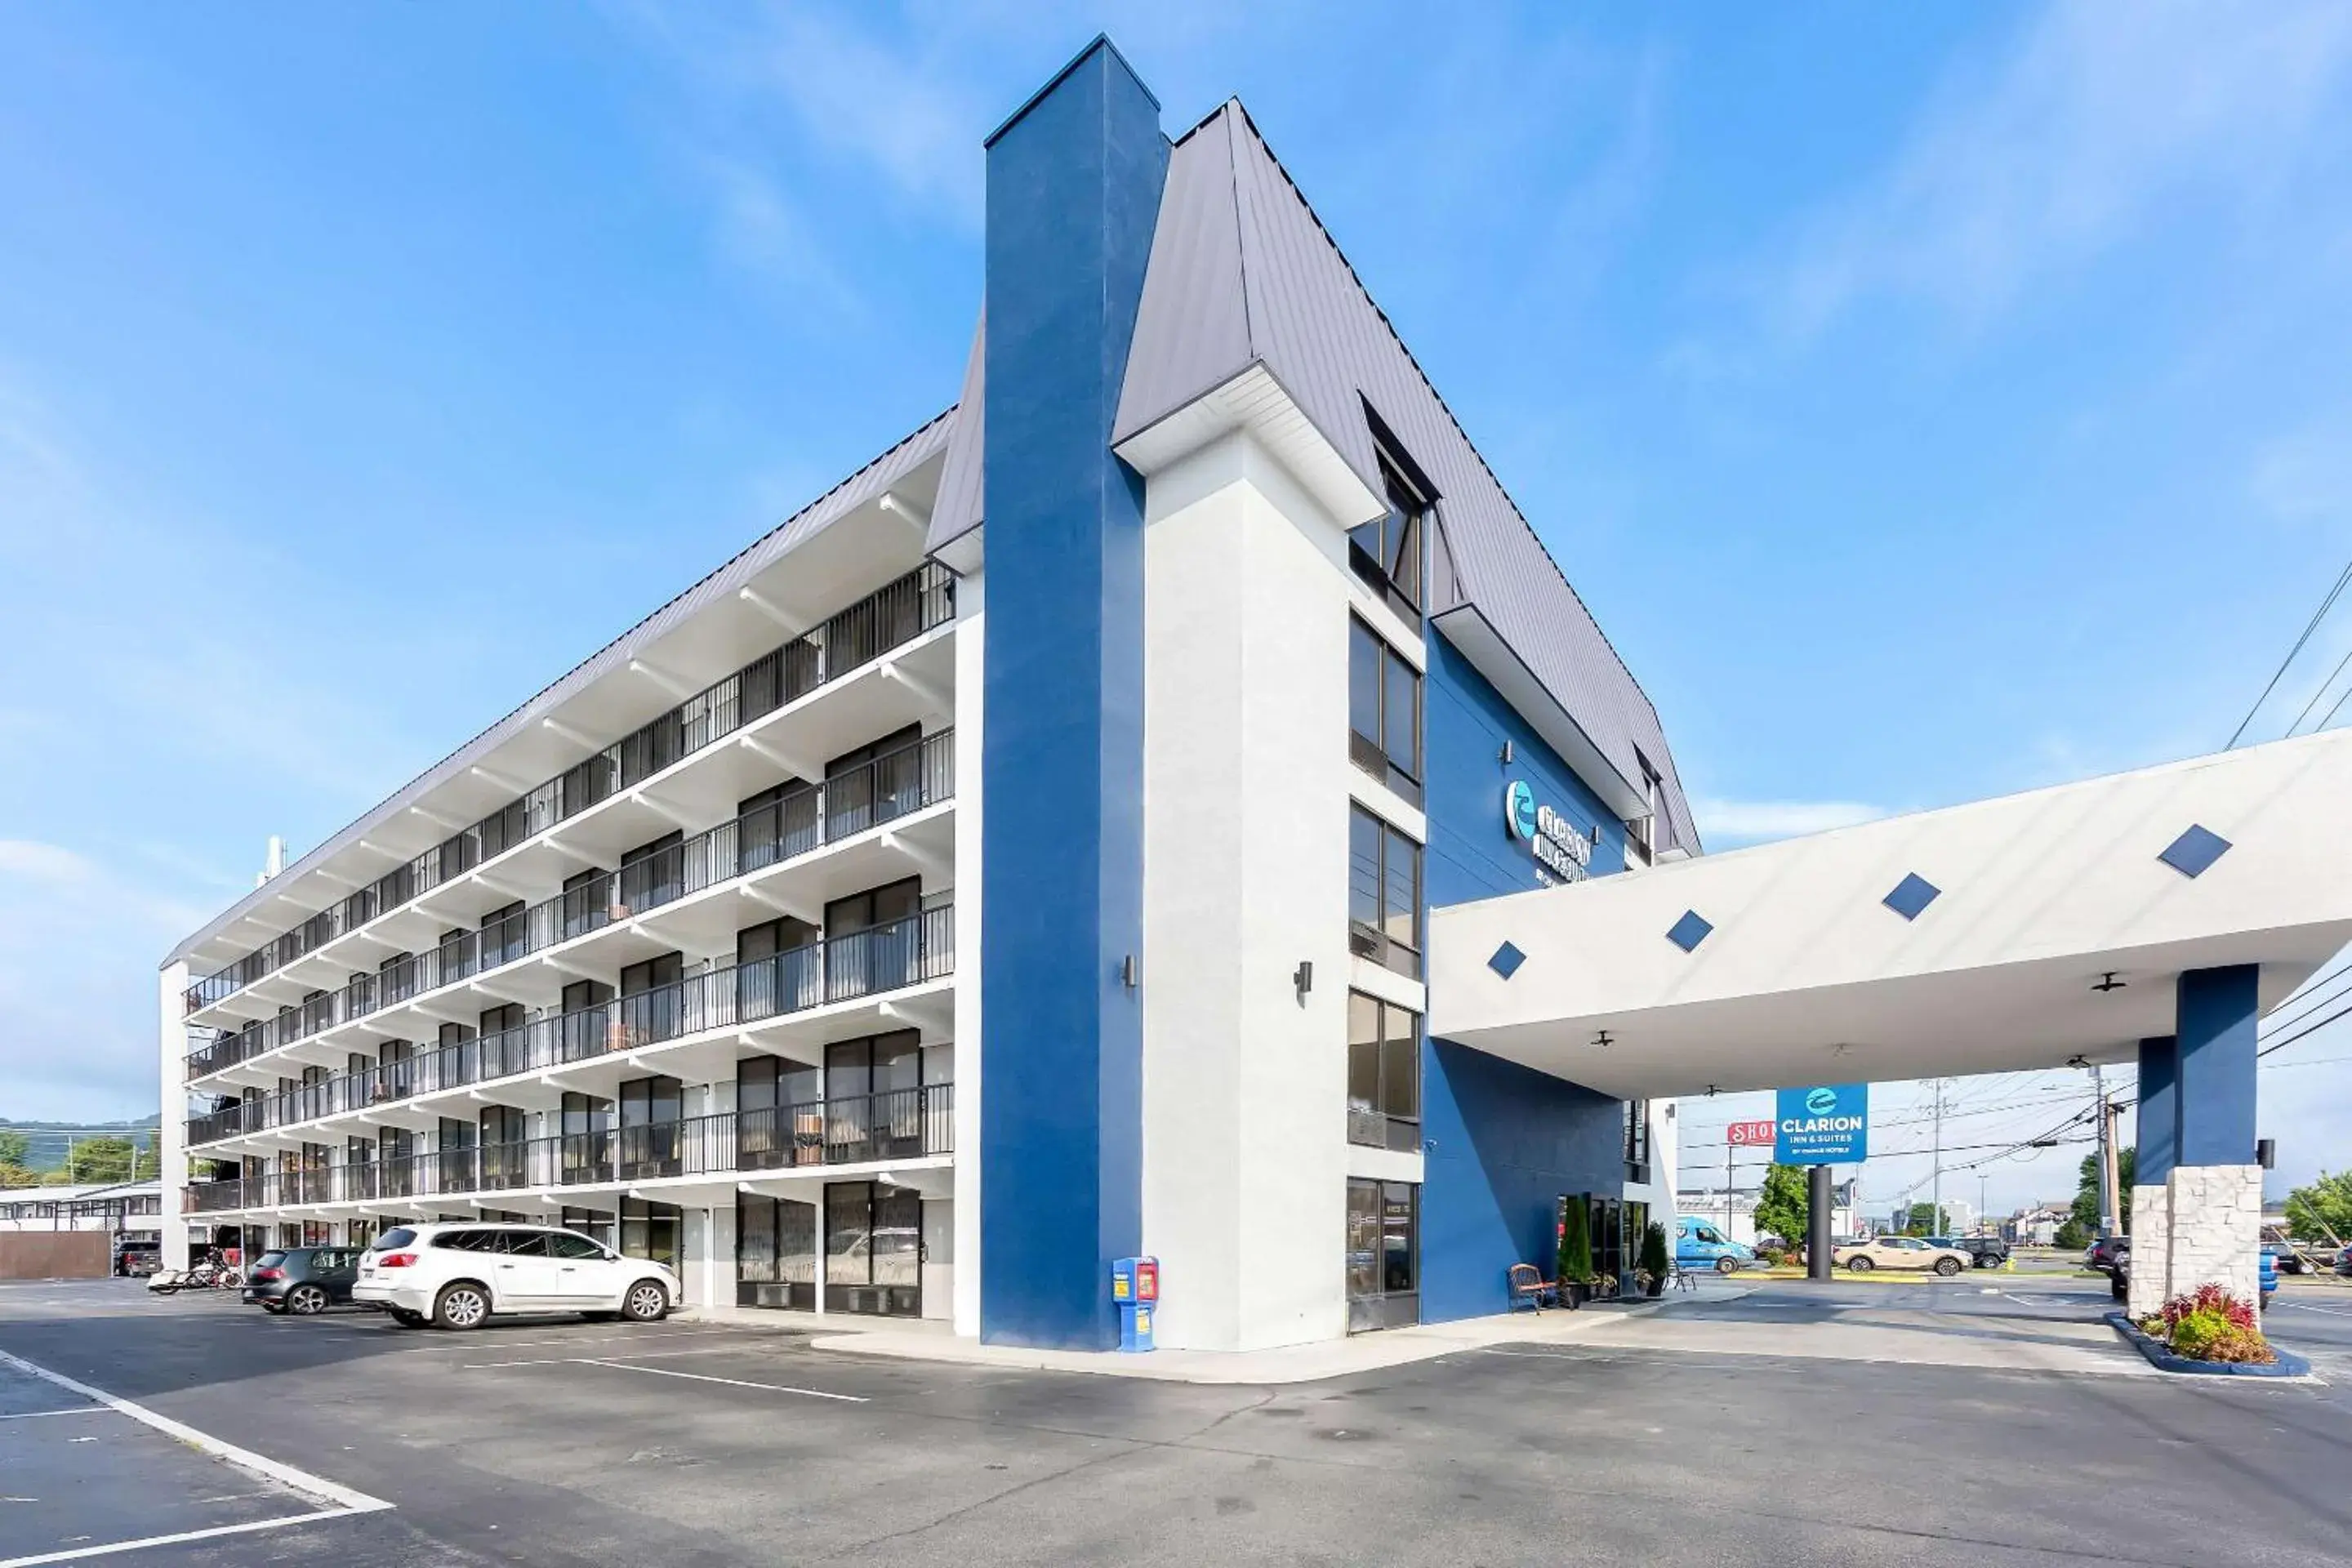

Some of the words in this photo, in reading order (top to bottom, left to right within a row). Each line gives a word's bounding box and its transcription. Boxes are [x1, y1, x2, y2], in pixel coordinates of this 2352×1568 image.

[1782, 1116, 1862, 1133] CLARION
[1790, 1136, 1806, 1144] INN
[1818, 1134, 1852, 1143] SUITES
